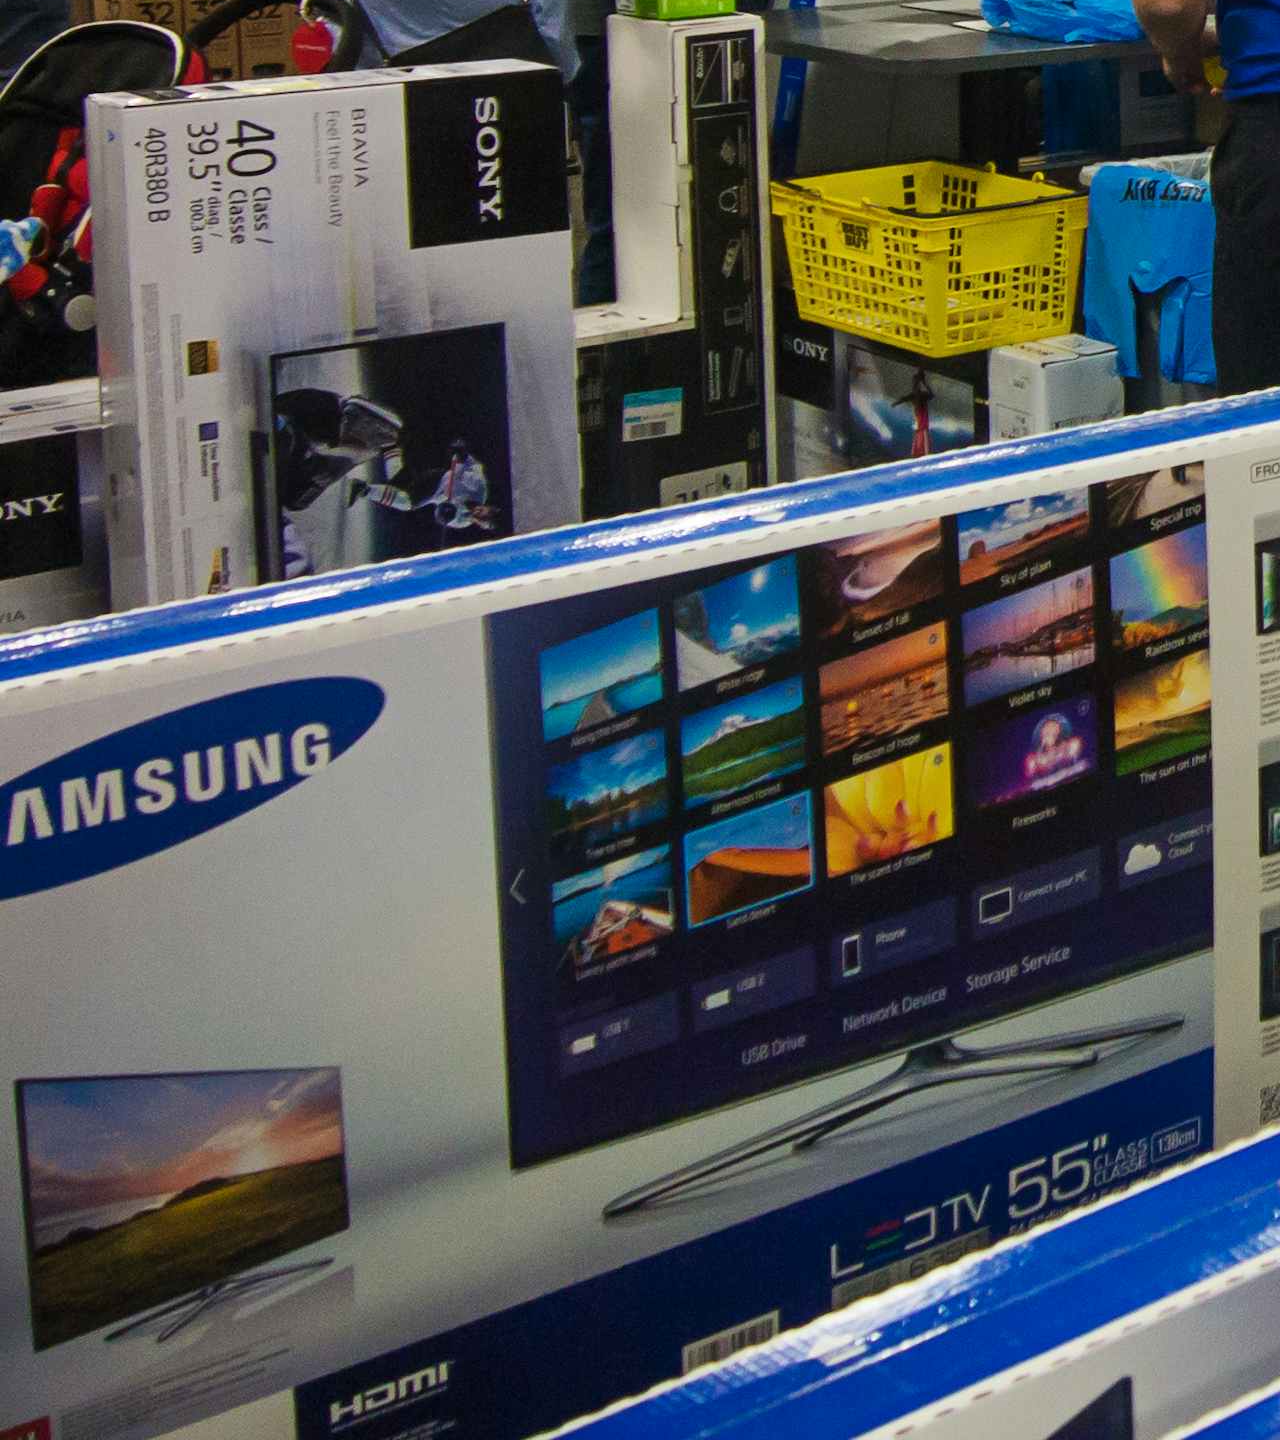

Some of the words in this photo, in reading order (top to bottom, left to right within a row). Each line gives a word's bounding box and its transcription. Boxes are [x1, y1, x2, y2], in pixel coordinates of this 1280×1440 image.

[137, 1, 175, 24] 32
[326, 110, 341, 141] Feel
[328, 145, 342, 170] the
[351, 107, 369, 188] BRAVIA
[475, 96, 503, 222] SONY
[226, 120, 277, 177] 40
[252, 186, 272, 231] Class
[228, 189, 248, 245] Classe
[327, 174, 343, 227] Beauty
[844, 236, 869, 250] BUY
[1150, 506, 1178, 532] Special
[1179, 502, 1202, 521] trip
[1009, 690, 1035, 709] Violet
[1037, 685, 1053, 701] sky
[6, 723, 333, 846] AMSUNG
[1140, 769, 1157, 784] The
[1158, 765, 1176, 779] sun
[1177, 761, 1189, 774] on
[1190, 753, 1208, 770] the
[1012, 806, 1057, 829] Fireworks
[1168, 841, 1193, 859] Cloud
[1018, 884, 1046, 904] Connect
[1075, 869, 1088, 884] PC
[875, 926, 907, 945] Phone
[741, 1045, 769, 1066] USB
[770, 1032, 807, 1058] Drive
[842, 1001, 900, 1034] Network
[901, 985, 948, 1016] Device
[965, 963, 1019, 994] Storage
[1021, 944, 1072, 975] Service
[1157, 1126, 1196, 1154] 138cm
[941, 1185, 992, 1233] TV
[1008, 1134, 1109, 1218] 55"
[1094, 1137, 1148, 1170] CLASS
[1093, 1153, 1148, 1188] CLASSE
[330, 1360, 455, 1425] HDMI
